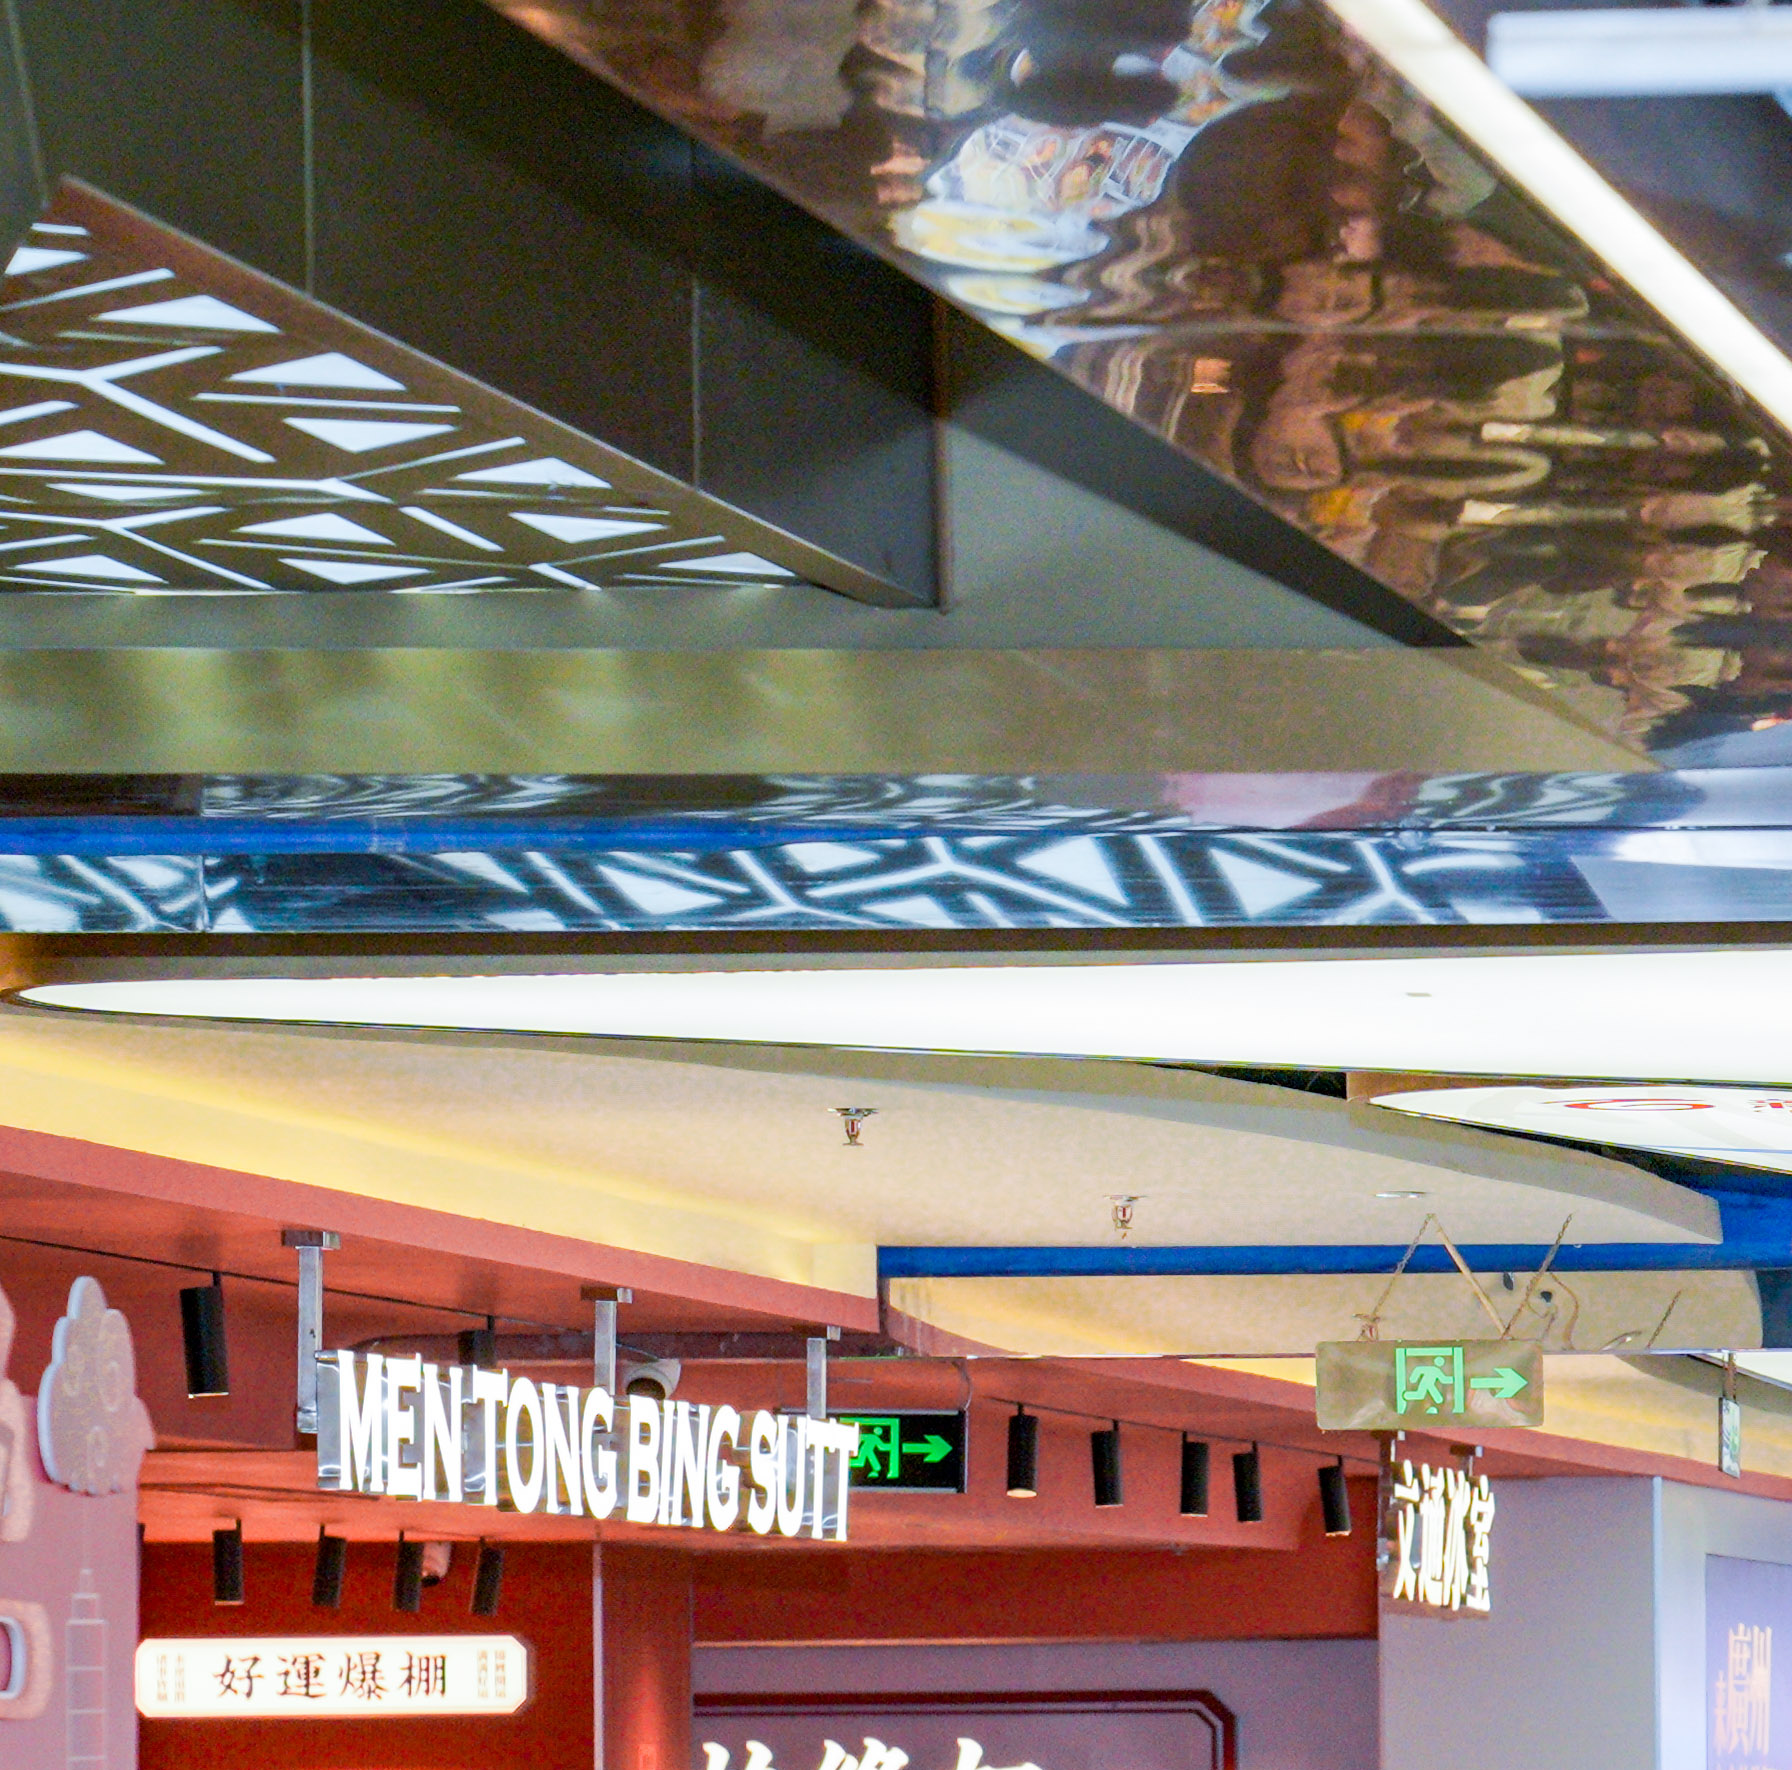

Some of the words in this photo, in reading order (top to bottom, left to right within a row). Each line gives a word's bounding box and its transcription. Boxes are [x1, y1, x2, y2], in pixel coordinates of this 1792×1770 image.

[338, 1350, 463, 1503] MEN
[472, 1365, 618, 1519] TONG
[627, 1394, 741, 1532] BING
[748, 1410, 859, 1541] SUTT
[214, 1650, 449, 1700] 好運爆棚
